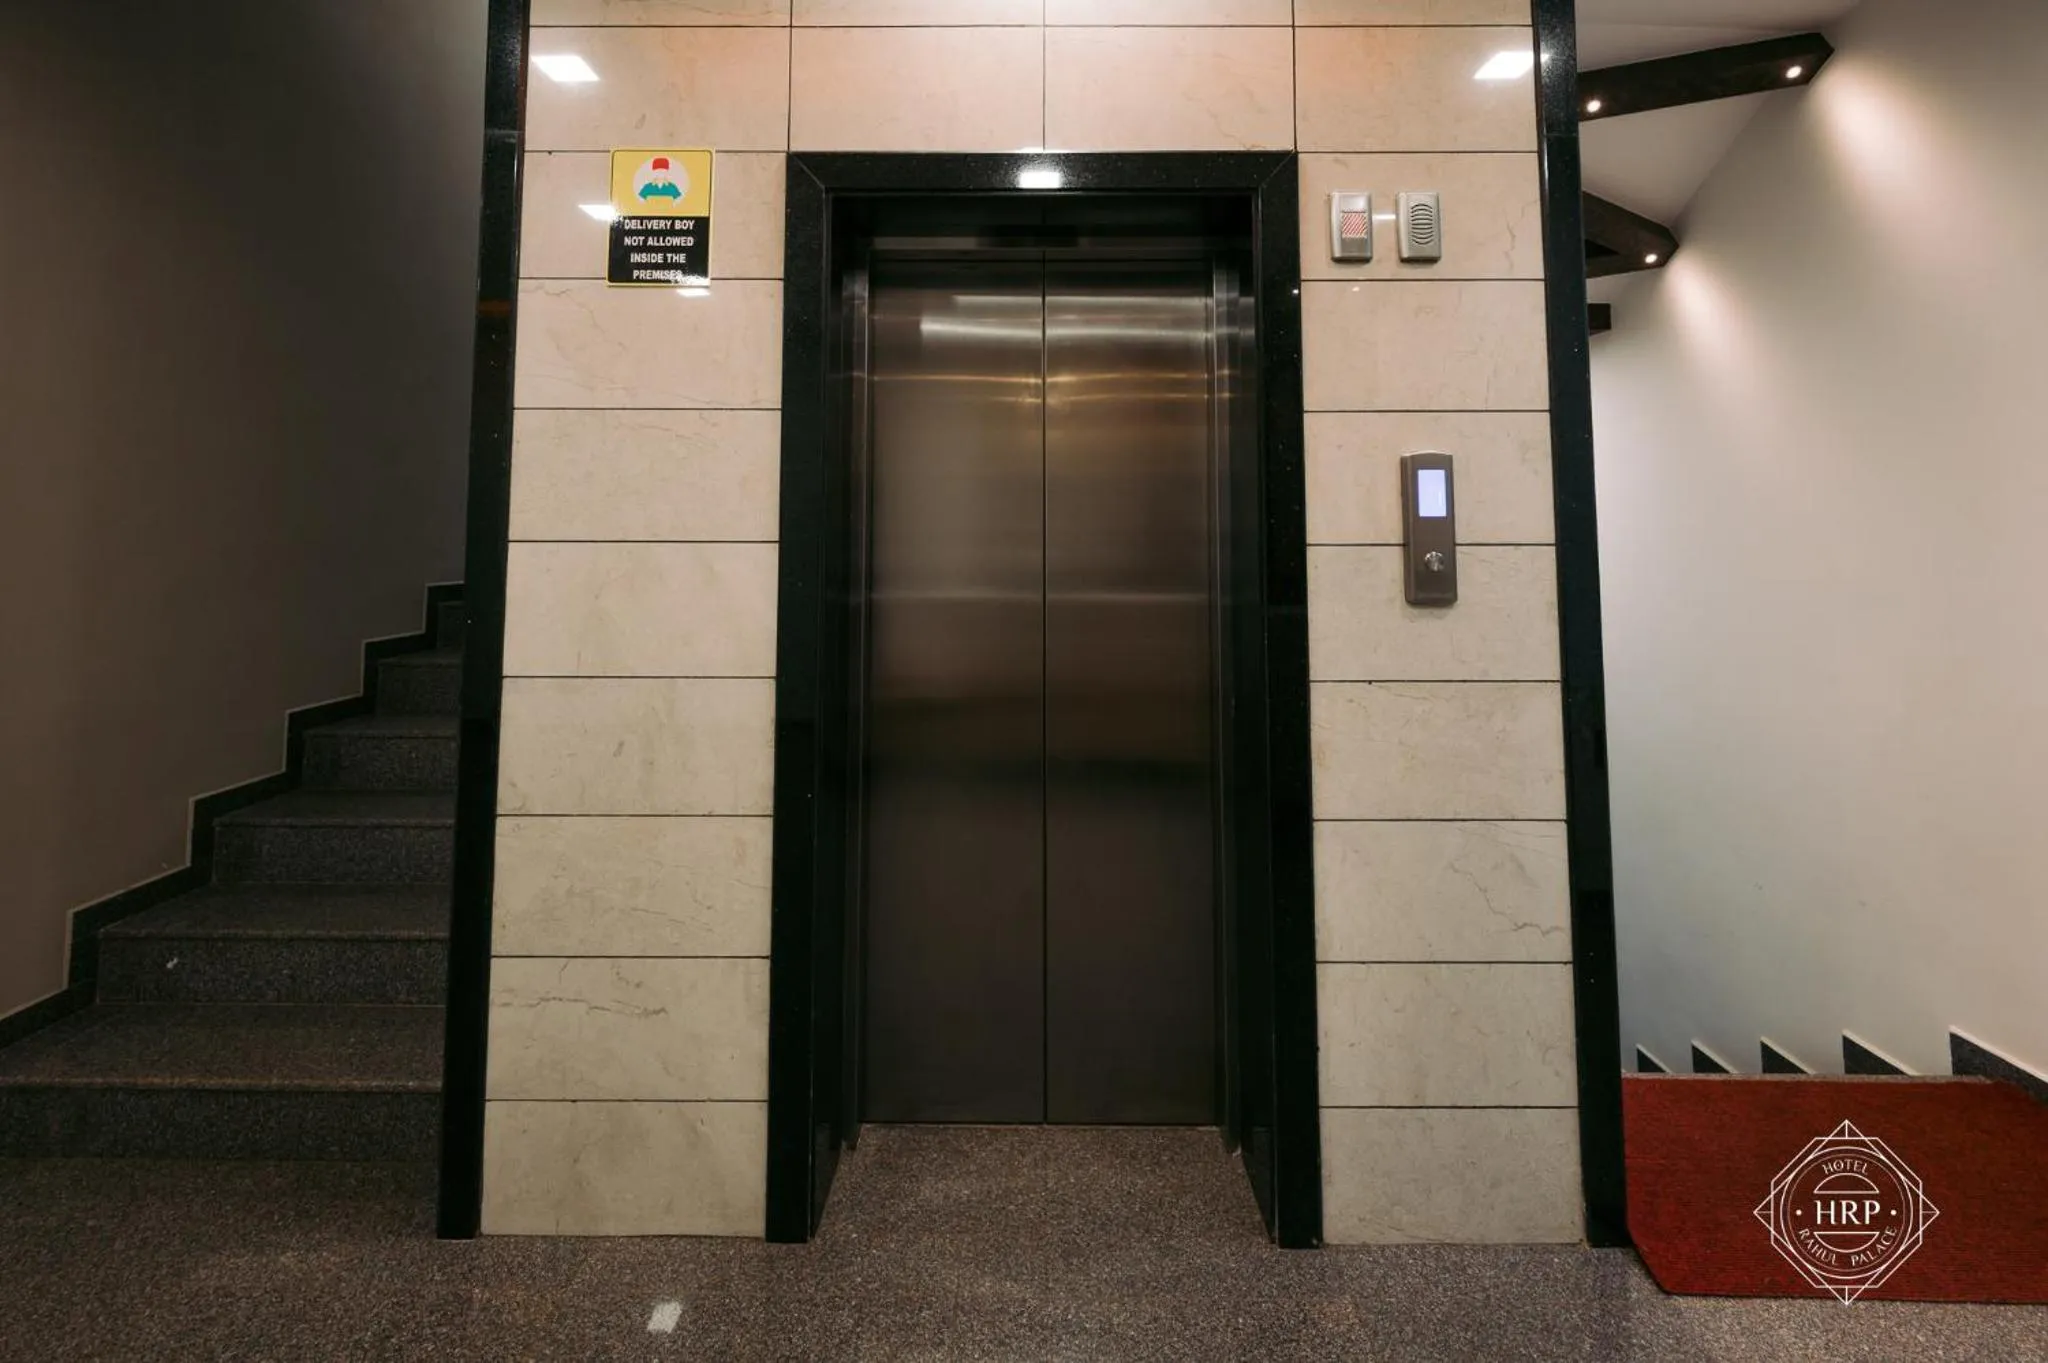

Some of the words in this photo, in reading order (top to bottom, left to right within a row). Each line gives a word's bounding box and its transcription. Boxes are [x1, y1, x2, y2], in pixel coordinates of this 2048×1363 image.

[624, 219, 672, 230] DELIVERY
[674, 219, 695, 230] BOY
[624, 236, 645, 246] NOT
[647, 236, 694, 246] ALLOWED
[630, 253, 664, 263] INSIDE
[666, 253, 686, 263] THE
